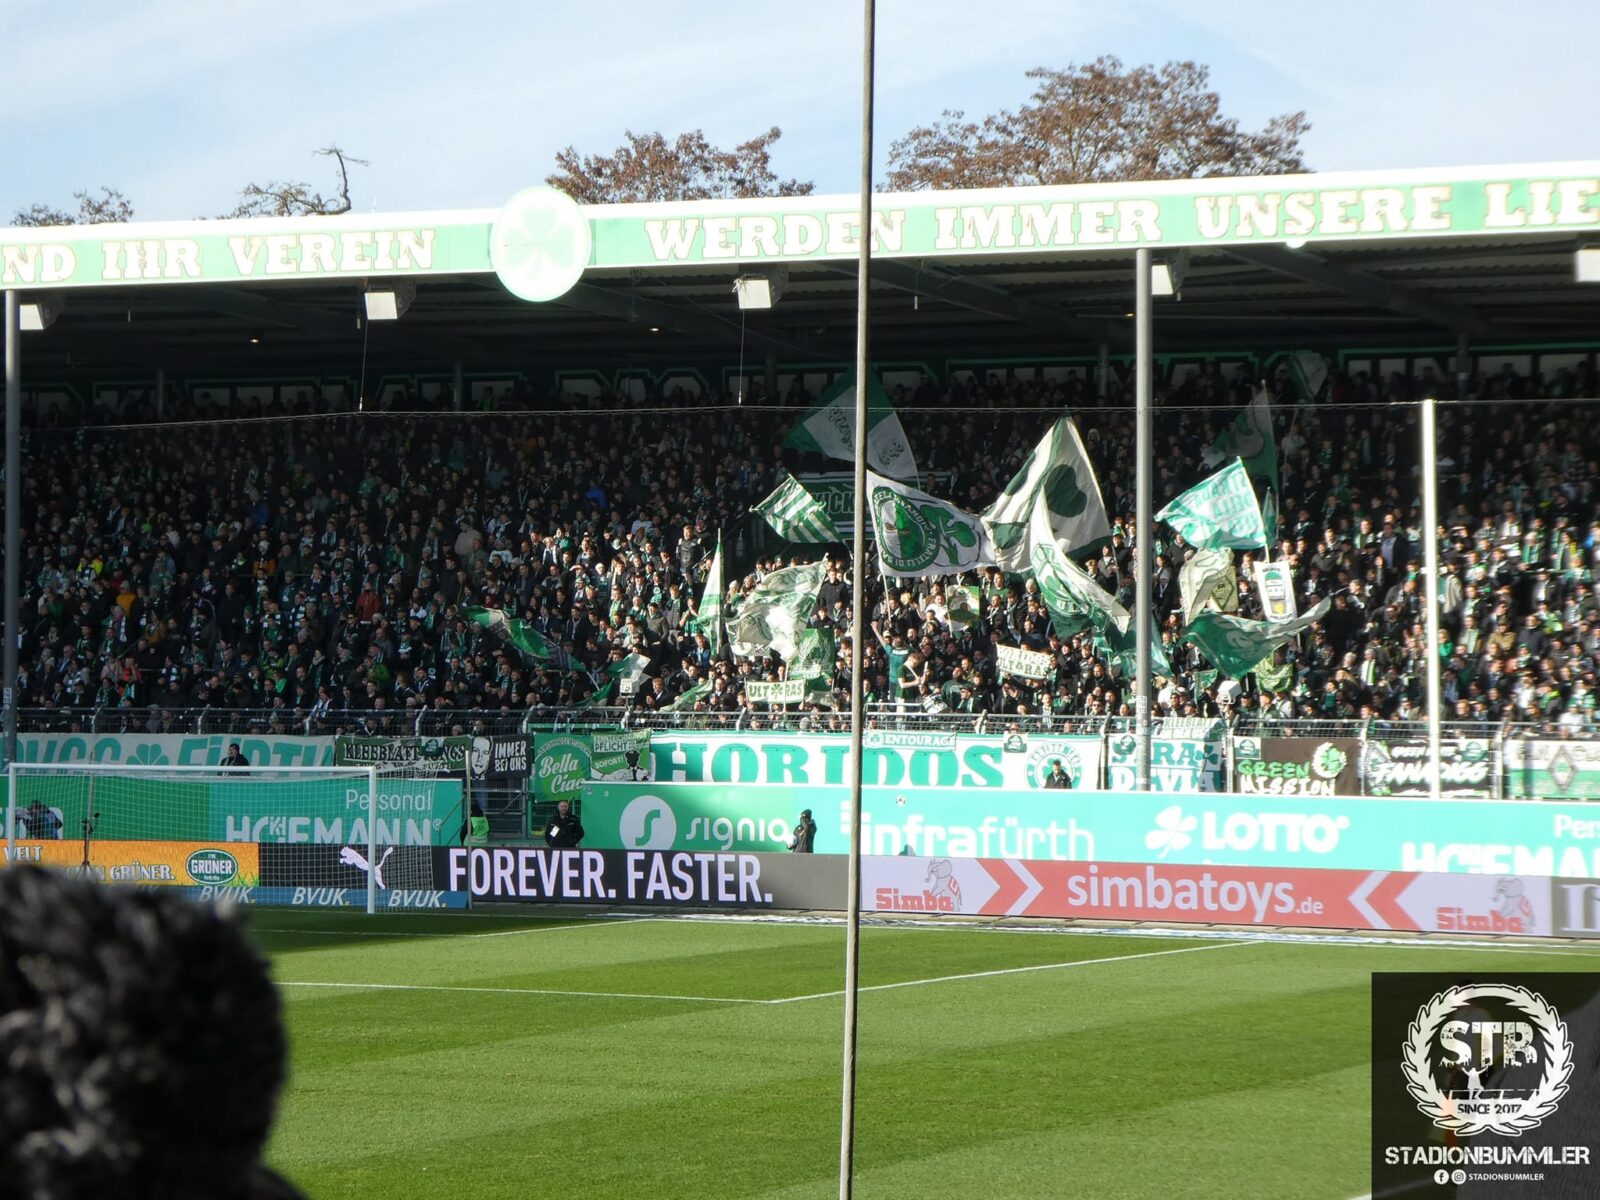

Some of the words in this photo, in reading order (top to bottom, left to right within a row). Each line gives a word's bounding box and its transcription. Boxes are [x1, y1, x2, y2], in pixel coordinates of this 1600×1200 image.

[101, 238, 201, 280] IHR
[228, 229, 435, 275] VEREIN
[644, 209, 905, 261] WERDEN
[935, 199, 1162, 251] IMMER
[1195, 185, 1452, 239] UNSERE
[1484, 177, 1600, 227] LIE
[495, 741, 526, 757] IMMER
[510, 757, 527, 771] UNS
[539, 753, 579, 778] Bella
[651, 742, 1004, 787] HORIDOS
[1238, 759, 1310, 779] GREEN
[551, 774, 586, 794] Ciao
[346, 789, 432, 811] Pesonal
[1203, 811, 1341, 853] LOTTO
[450, 848, 617, 898] FOREVER.
[627, 852, 773, 903] FASTER.
[875, 887, 954, 912] Simba
